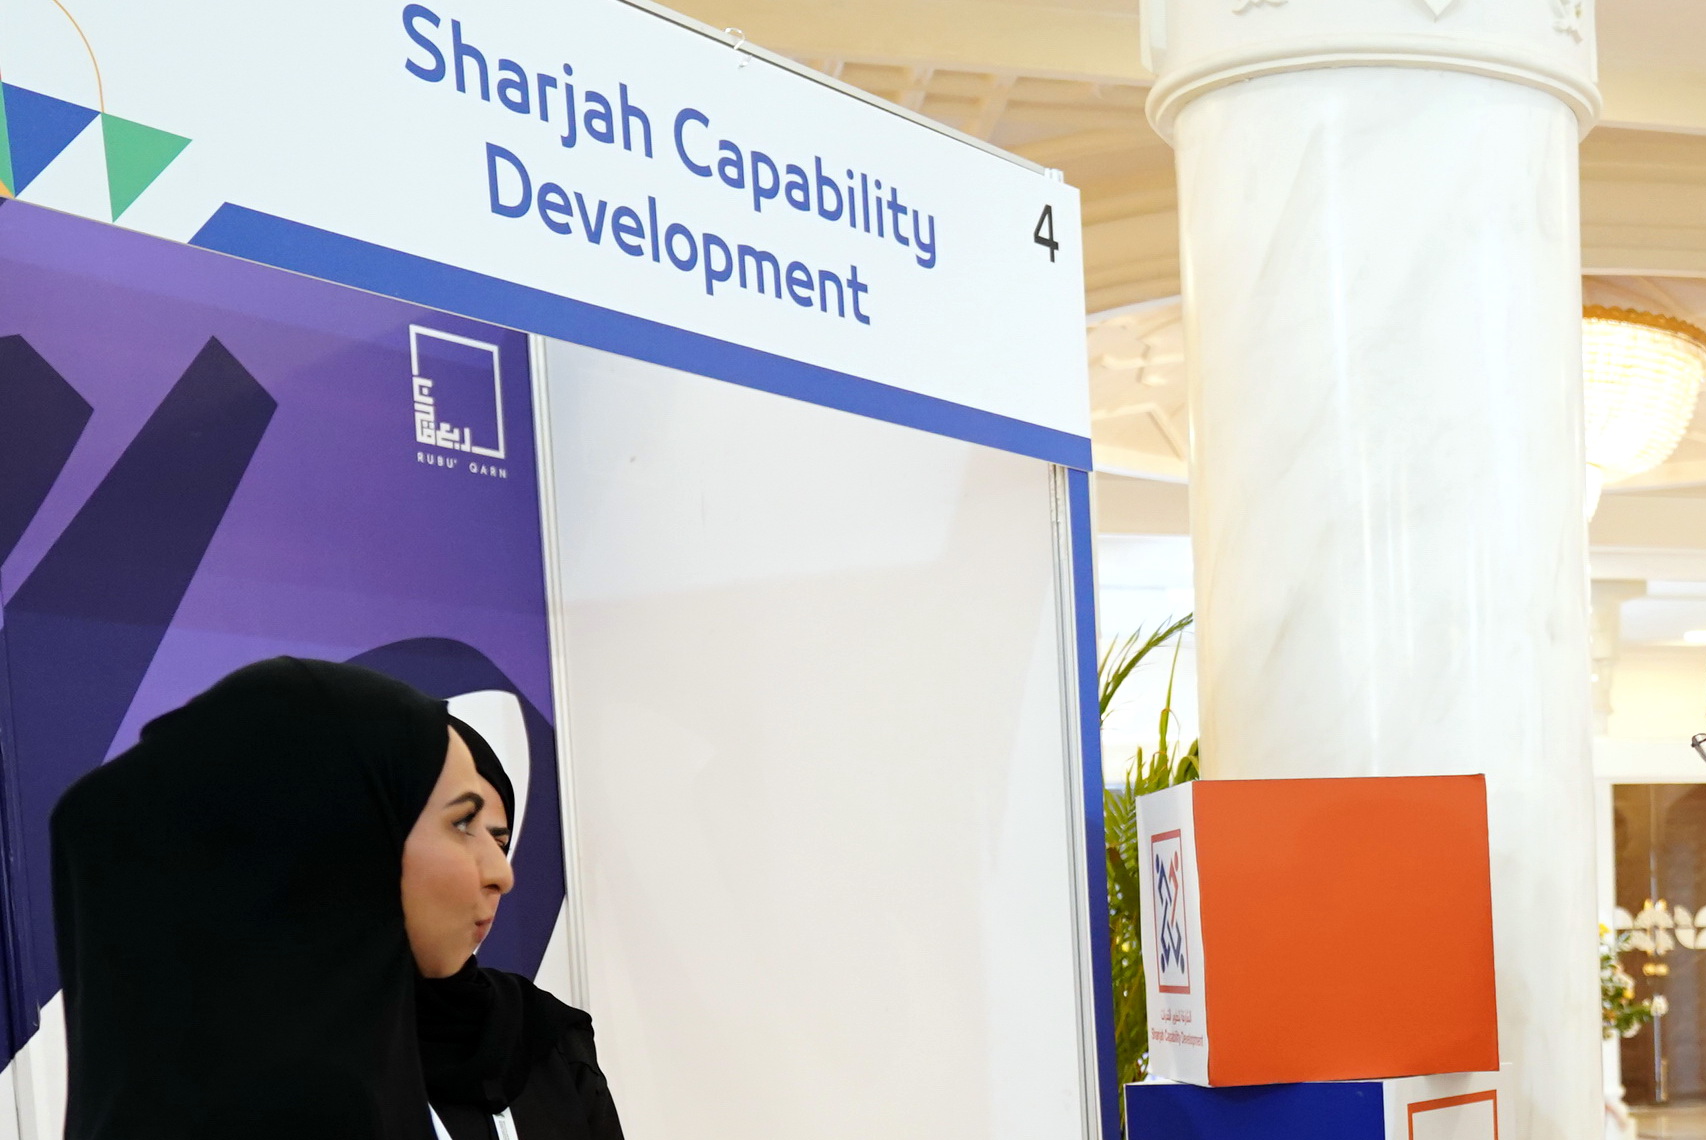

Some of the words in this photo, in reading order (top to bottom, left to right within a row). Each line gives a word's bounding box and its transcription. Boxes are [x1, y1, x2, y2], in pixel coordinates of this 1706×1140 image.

[402, 3, 654, 159] Sharjah
[673, 107, 937, 270] Capability
[485, 141, 872, 326] Development
[1033, 203, 1060, 263] 4
[468, 461, 508, 479] QARN
